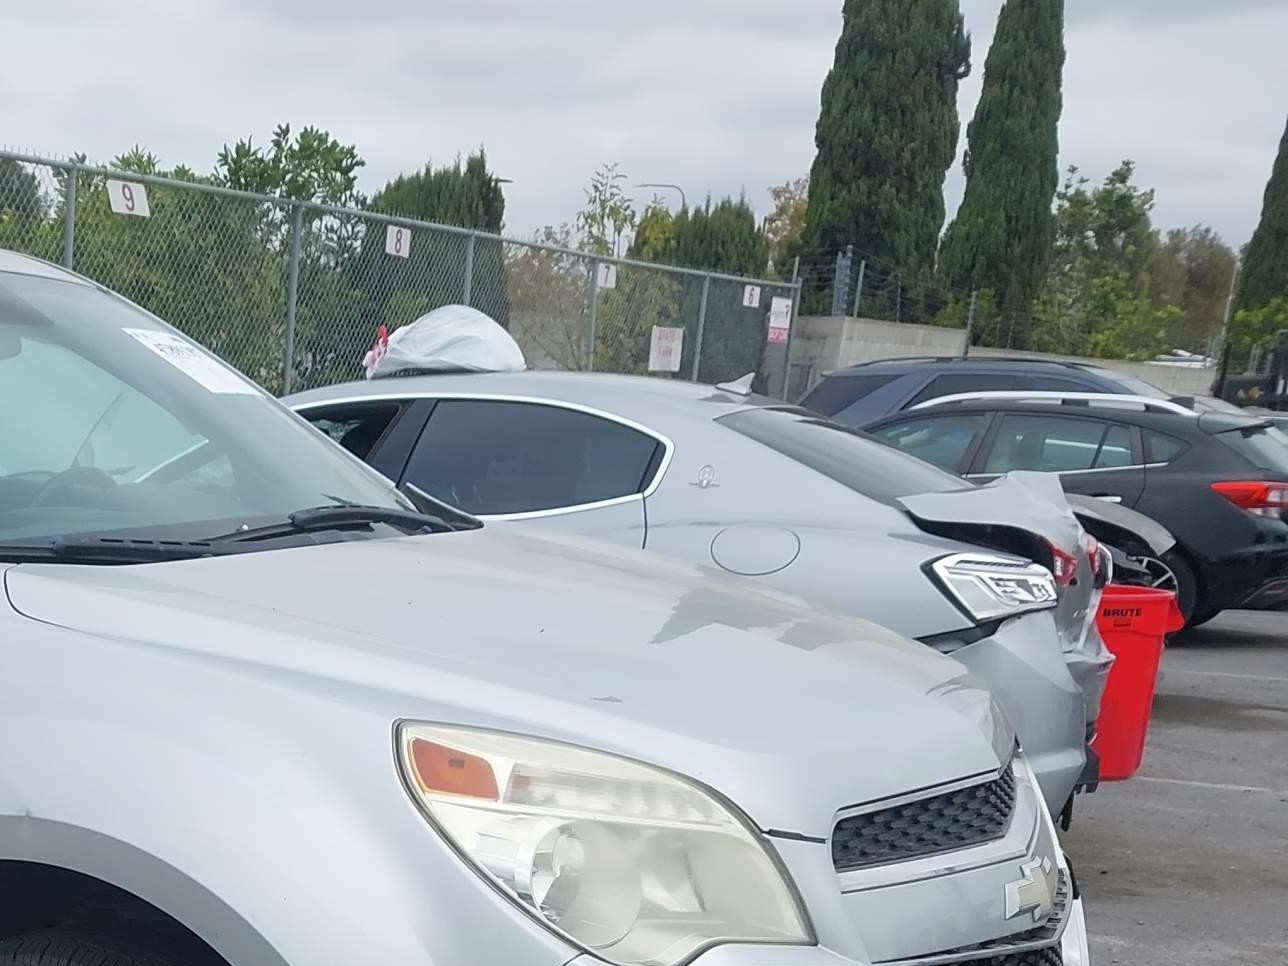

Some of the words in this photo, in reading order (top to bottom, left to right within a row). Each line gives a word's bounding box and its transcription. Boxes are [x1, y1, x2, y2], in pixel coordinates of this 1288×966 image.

[122, 183, 135, 212] 9
[394, 229, 402, 254] 8
[604, 264, 610, 286] 7
[748, 287, 755, 305] 6
[1103, 607, 1142, 616] BRUTE
